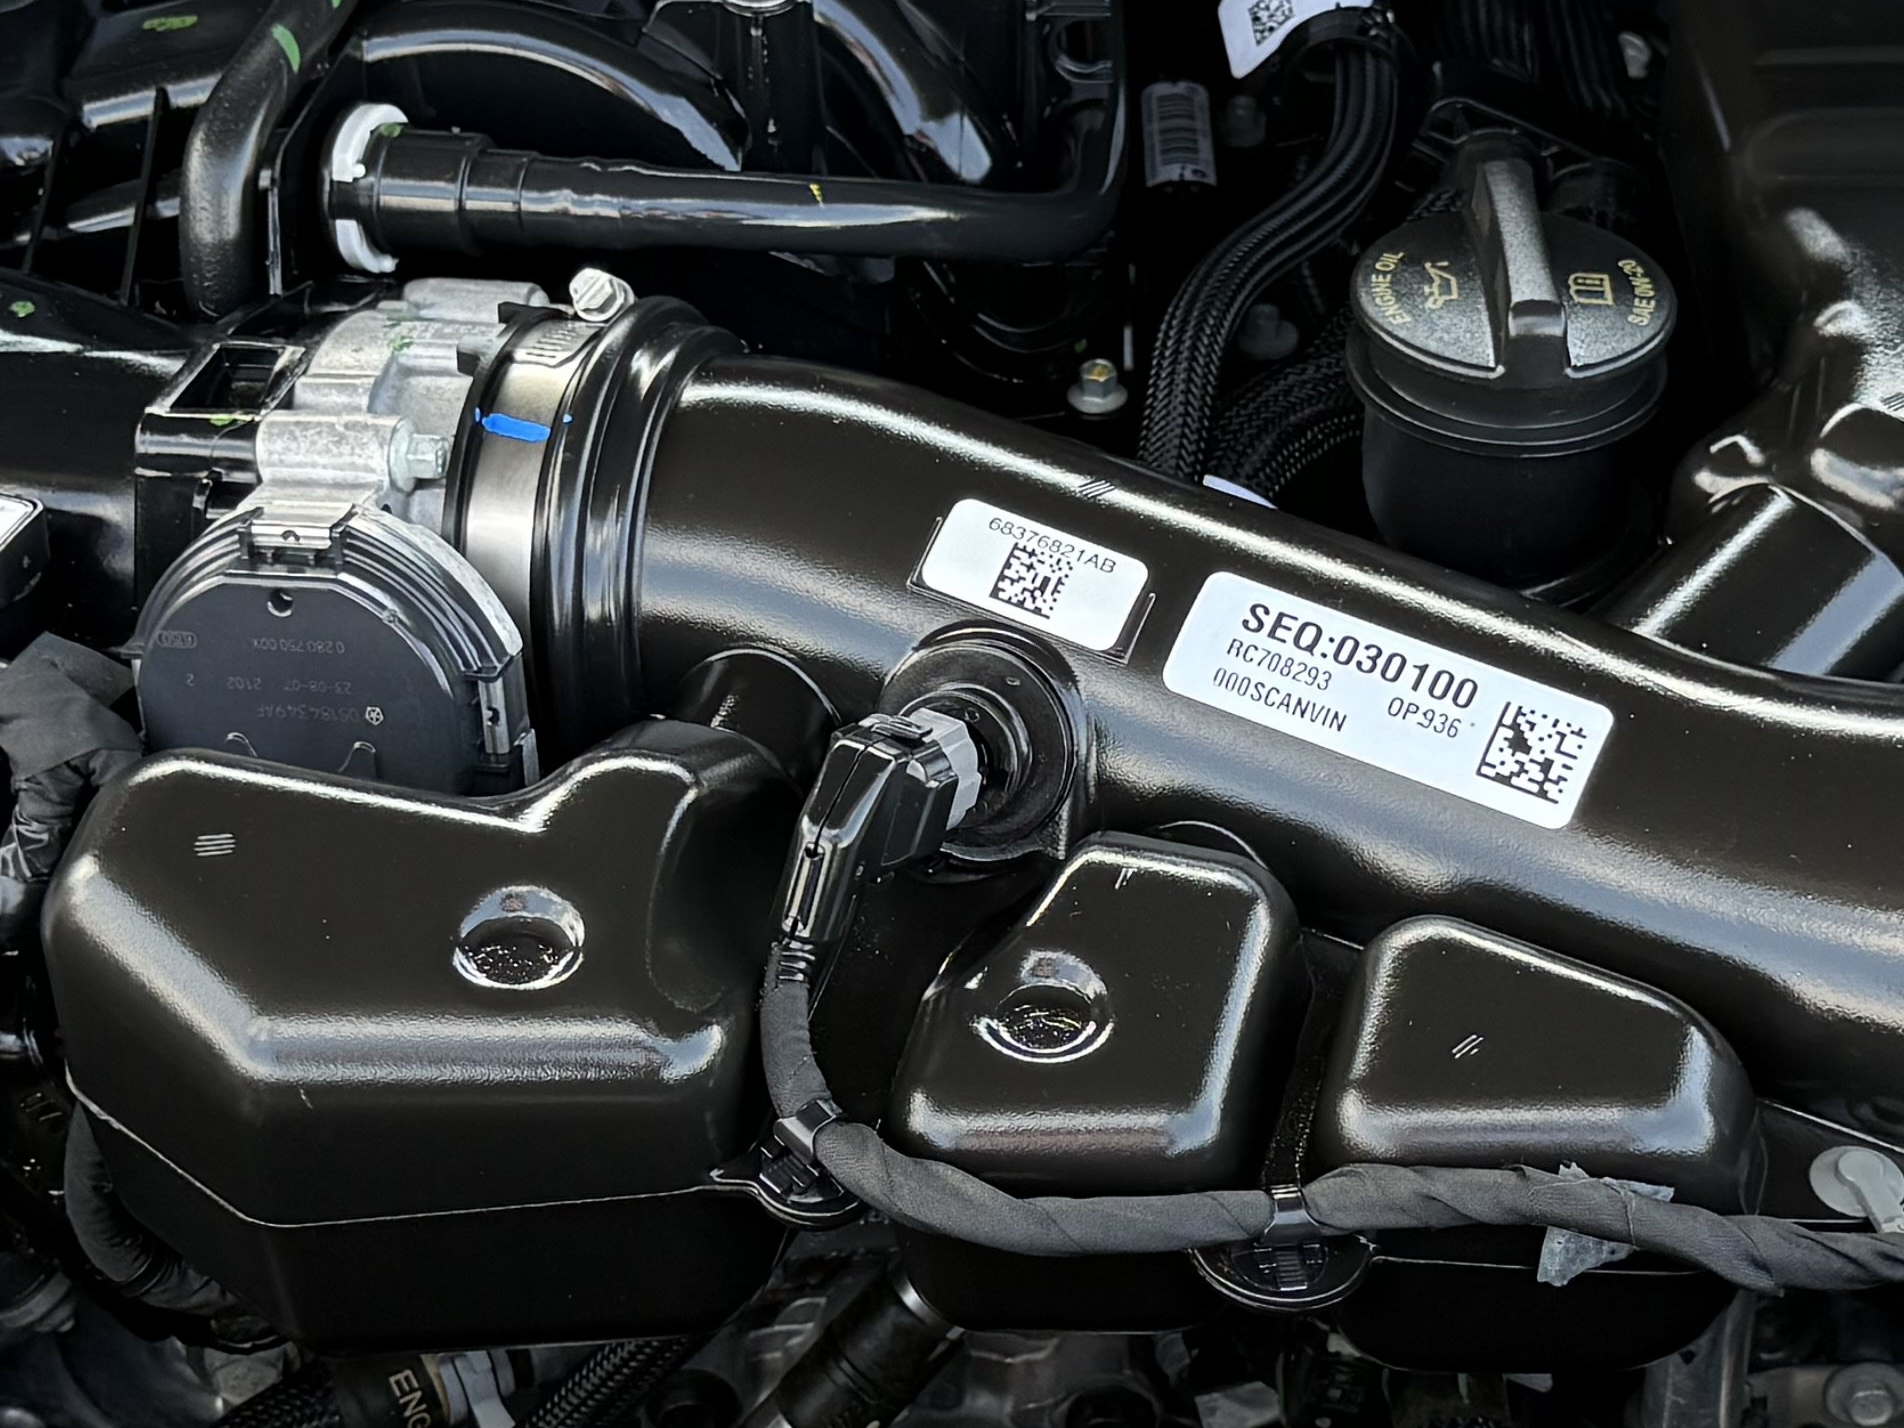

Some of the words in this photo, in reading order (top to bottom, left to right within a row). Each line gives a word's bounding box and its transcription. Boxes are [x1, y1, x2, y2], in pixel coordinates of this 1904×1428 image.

[1375, 251, 1404, 272] OIL
[1371, 273, 1412, 325] ENGINE
[1627, 297, 1656, 326] SAE
[989, 516, 1117, 574] 68376821AB
[1226, 637, 1333, 691] RC708293
[1241, 602, 1481, 711] SEQ:030100
[1212, 667, 1347, 733] 000SCANVIN
